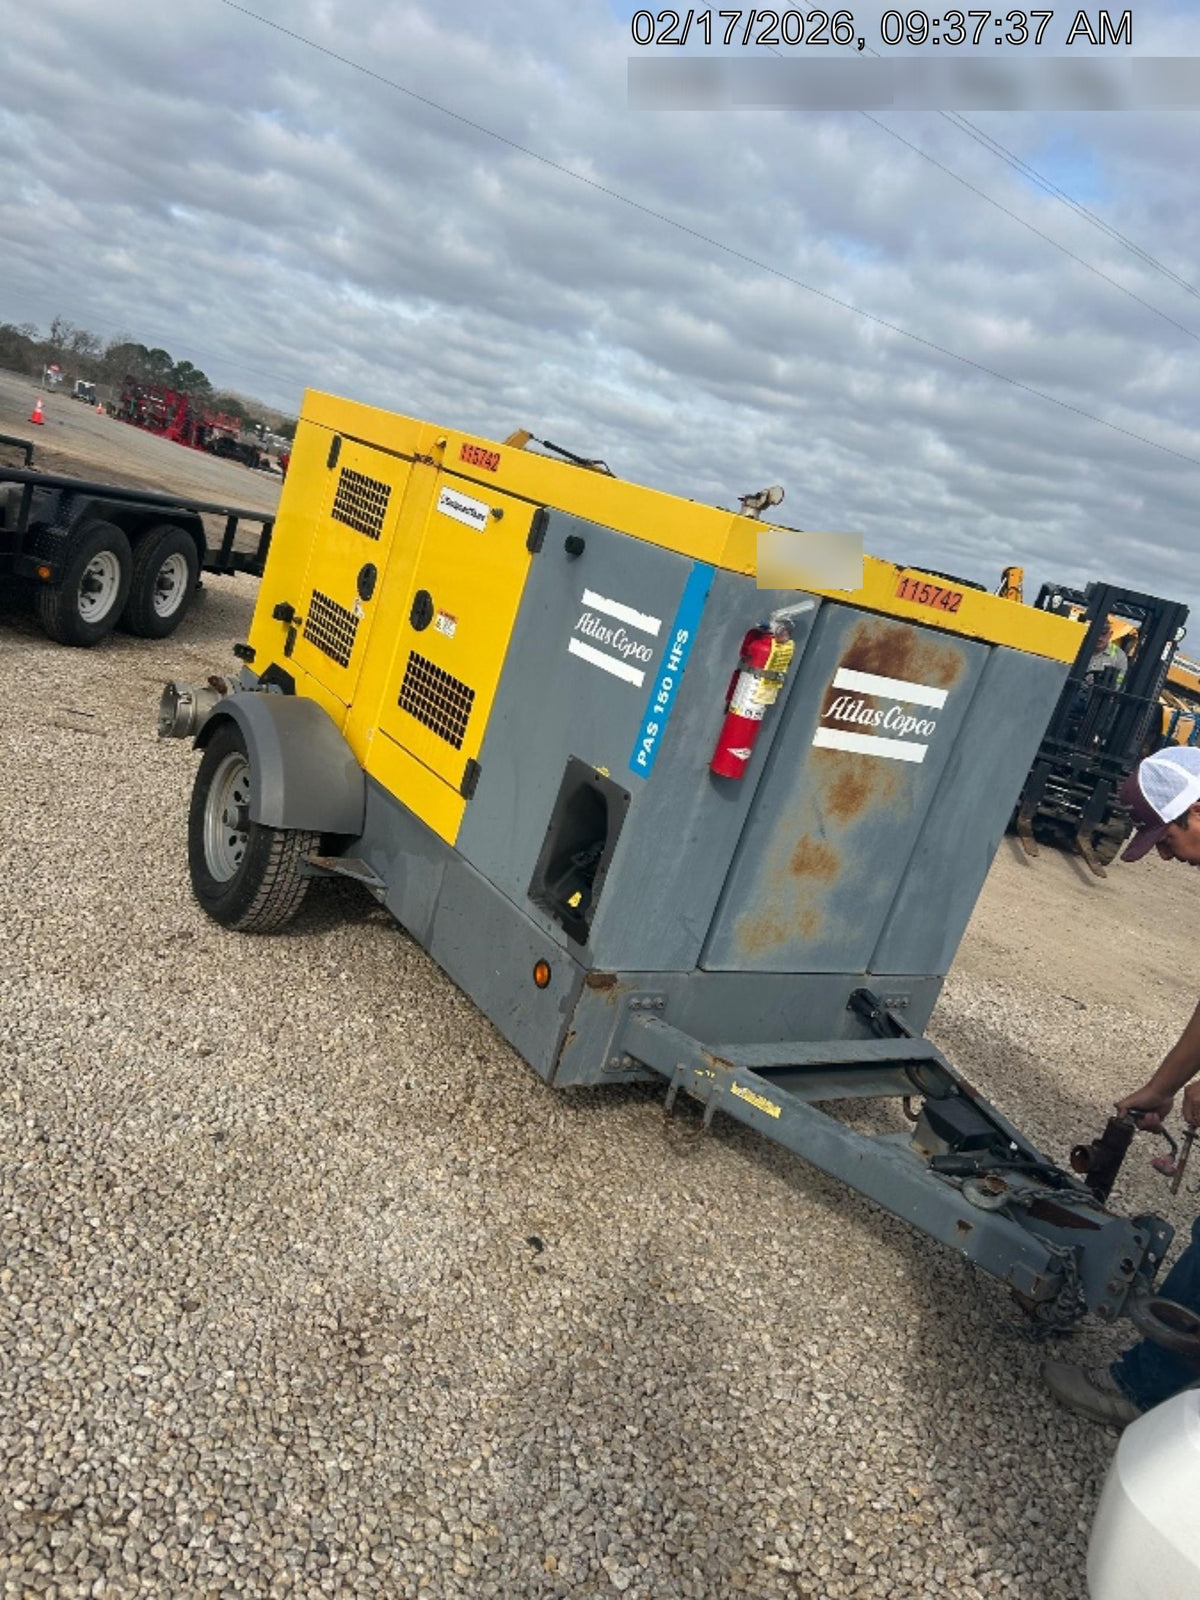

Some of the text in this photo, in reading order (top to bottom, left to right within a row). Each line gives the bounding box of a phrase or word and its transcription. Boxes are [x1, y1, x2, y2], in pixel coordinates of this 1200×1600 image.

[900, 577, 963, 613] 115742
[636, 629, 689, 767] PAS 150 HFS
